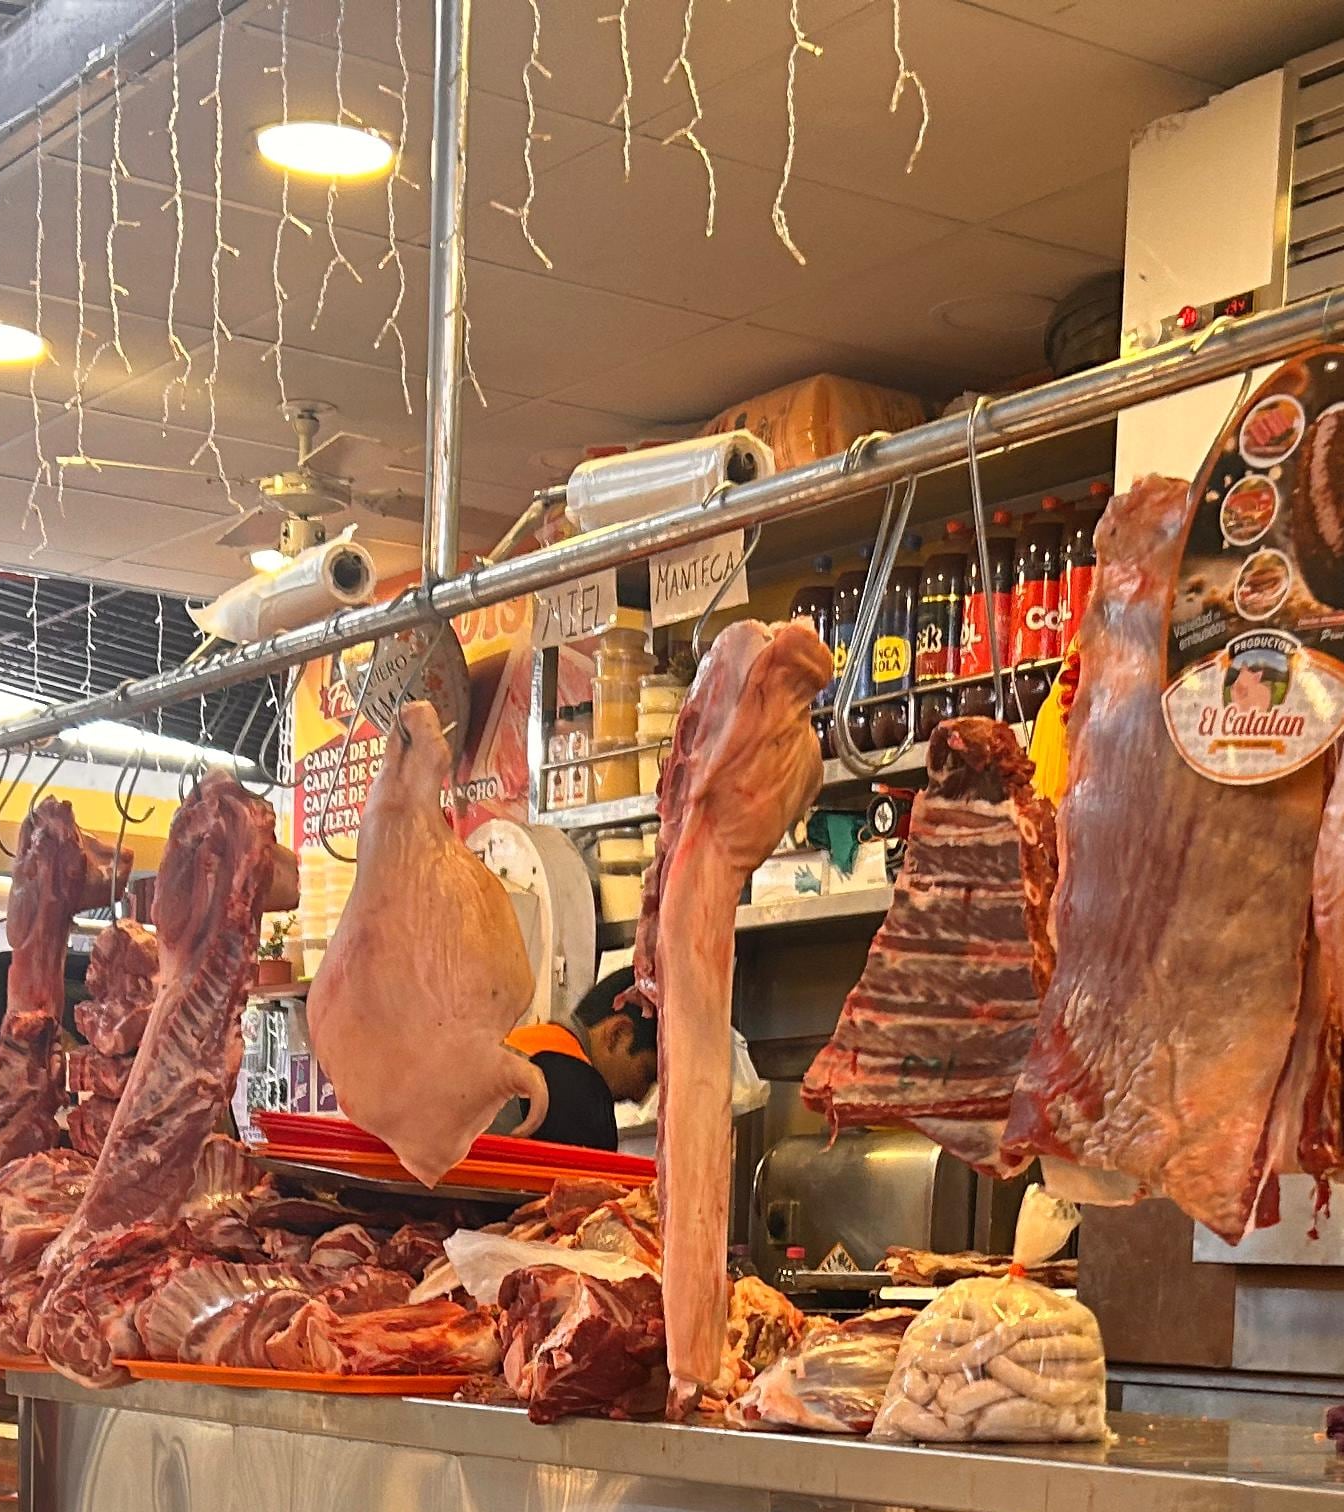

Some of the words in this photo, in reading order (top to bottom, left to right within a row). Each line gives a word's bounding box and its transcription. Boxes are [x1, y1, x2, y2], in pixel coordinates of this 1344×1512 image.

[656, 551, 735, 603] MANTECA
[542, 584, 605, 641] MIEL
[1198, 706, 1218, 737] El
[1221, 703, 1305, 737] Catalán
[350, 740, 368, 760] DE
[349, 765, 367, 783] DE
[349, 786, 367, 803] DE
